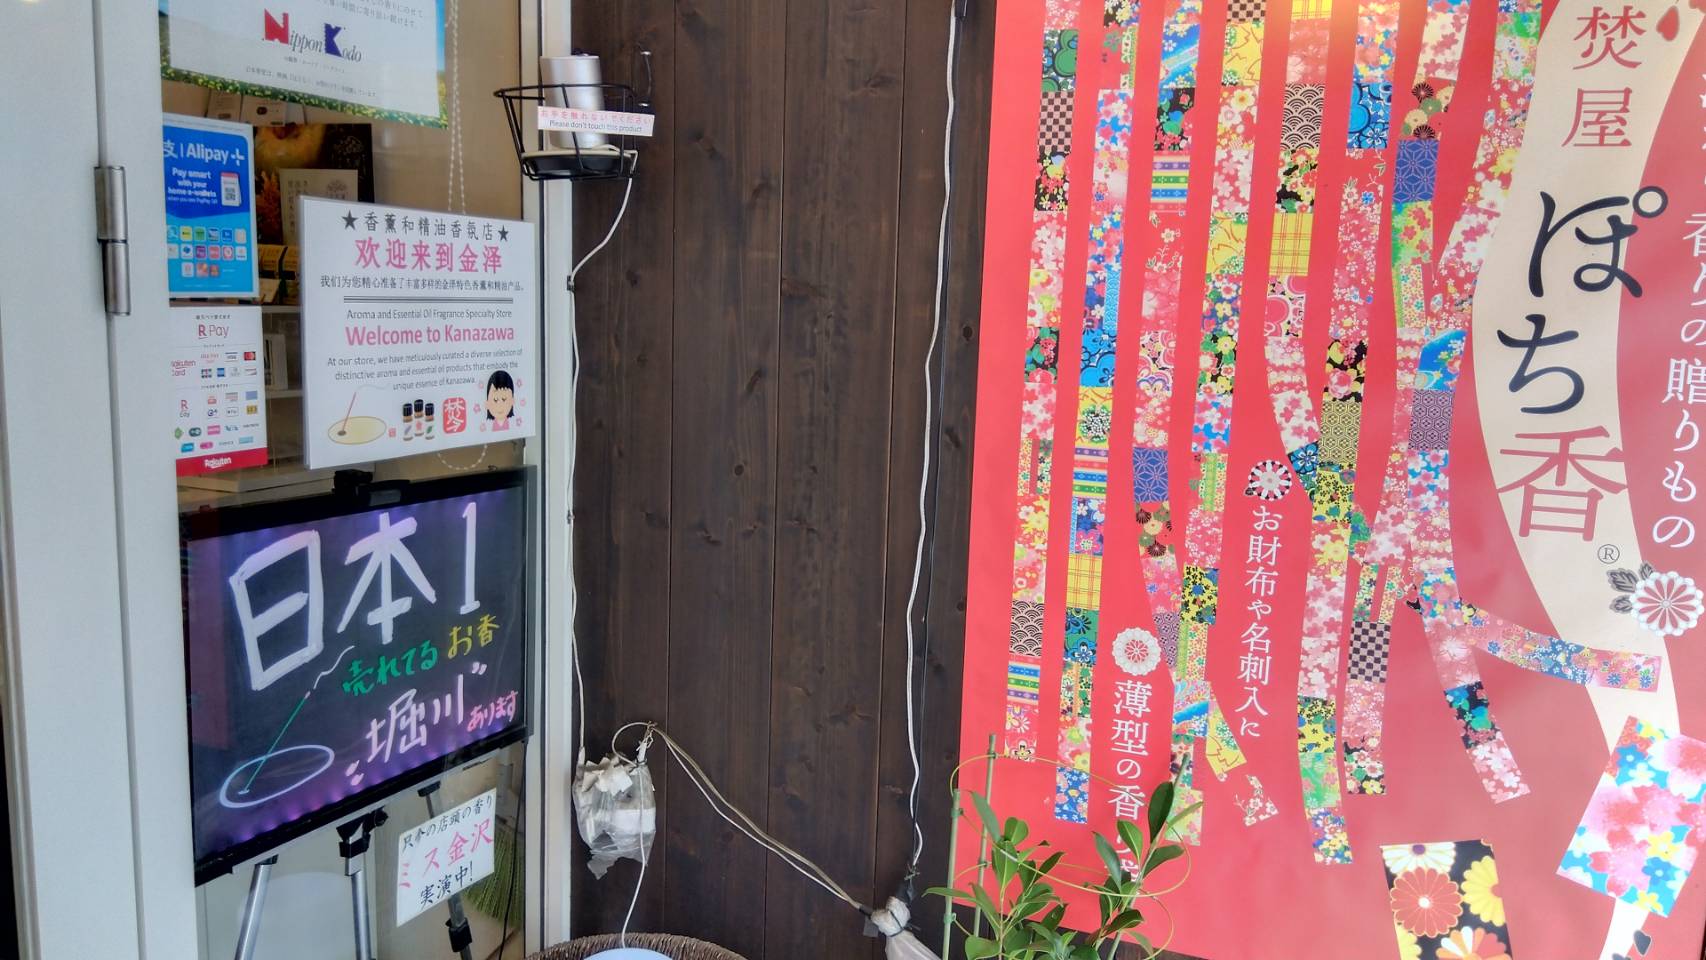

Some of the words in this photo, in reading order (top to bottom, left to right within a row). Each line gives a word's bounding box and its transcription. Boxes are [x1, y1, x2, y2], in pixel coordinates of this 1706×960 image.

[264, 8, 322, 54] Nippon
[324, 22, 362, 62] Kodo
[1561, 5, 1648, 147] 焚屋
[549, 119, 569, 127] Please
[571, 121, 587, 129] don't
[588, 122, 605, 130] touch
[172, 167, 187, 179] Pay
[188, 170, 211, 179] smart
[167, 186, 184, 194] home
[177, 179, 192, 187] with
[355, 236, 502, 274] 欢迎来到金泽
[346, 309, 376, 319] Aroma
[377, 309, 392, 319] and
[393, 309, 422, 319] Essential
[423, 309, 432, 318] Oil
[433, 309, 465, 320] Fragrance
[466, 309, 495, 320] Specialty
[496, 309, 512, 318] Store
[209, 324, 229, 338] Pay
[345, 325, 422, 346] Welcome
[427, 326, 441, 343] to
[445, 324, 515, 342] Kanazawa
[327, 357, 336, 366] At
[338, 358, 352, 366] our
[354, 356, 376, 366] store,
[389, 355, 404, 363] have
[442, 350, 465, 359] curated
[470, 350, 491, 358] diverse
[493, 348, 516, 357] selection
[1496, 185, 1669, 542] ぽち香
[335, 370, 375, 380] distinctive
[376, 369, 397, 378] aroma
[399, 368, 411, 376] and
[411, 365, 437, 376] essential
[446, 364, 472, 374] products
[472, 362, 485, 371] that
[486, 361, 508, 370] embody
[393, 381, 414, 391] unique
[415, 380, 438, 388] essence
[204, 457, 232, 468] Rakuten
[1235, 505, 1283, 738] お財布や名刺入に
[467, 690, 518, 732] あります
